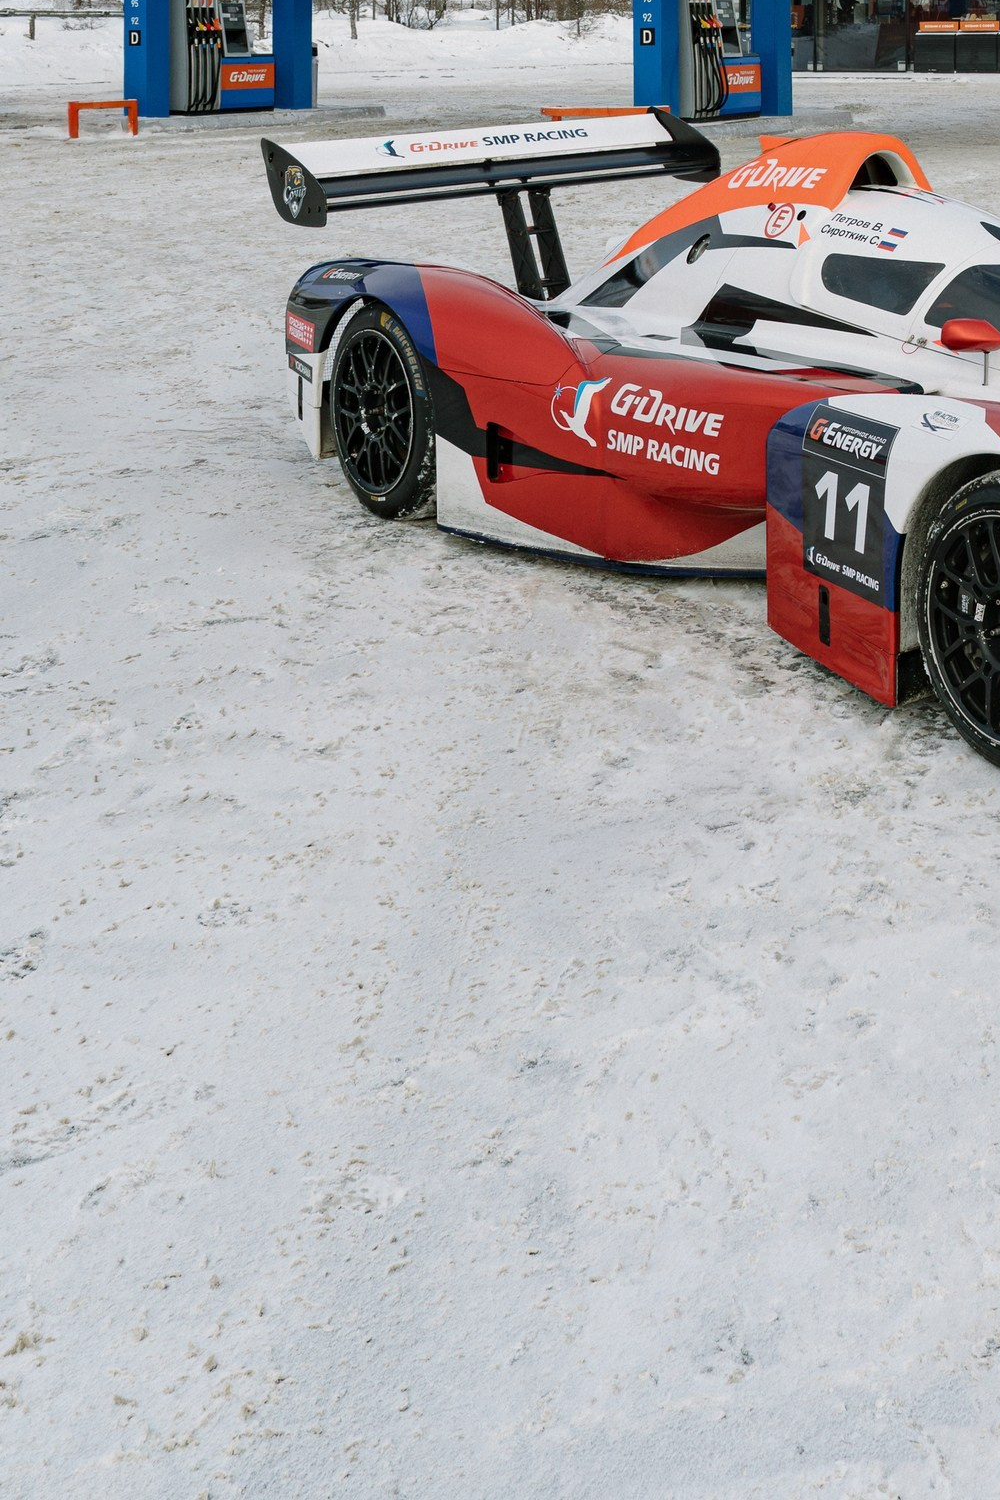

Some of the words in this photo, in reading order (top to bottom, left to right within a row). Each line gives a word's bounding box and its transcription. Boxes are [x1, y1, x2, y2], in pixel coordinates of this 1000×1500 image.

[130, 0, 139, 8] 95
[130, 17, 139, 26] 92
[642, 13, 652, 23] 92
[131, 32, 139, 45] D
[642, 29, 653, 44] D
[482, 134, 520, 147] SMP
[523, 127, 589, 143] RACING
[772, 209, 790, 229] E
[831, 212, 871, 230] Петров
[872, 222, 884, 233] В.
[820, 224, 869, 244] Сироткин
[869, 235, 880, 247] С.
[392, 325, 424, 391] MICHELIN
[841, 425, 868, 440] МОТОРНОЕ
[606, 429, 644, 457] SMP
[646, 438, 721, 476] RACING
[814, 470, 871, 556] 11
[842, 564, 856, 580] SMP
[856, 570, 880, 592] RACING
